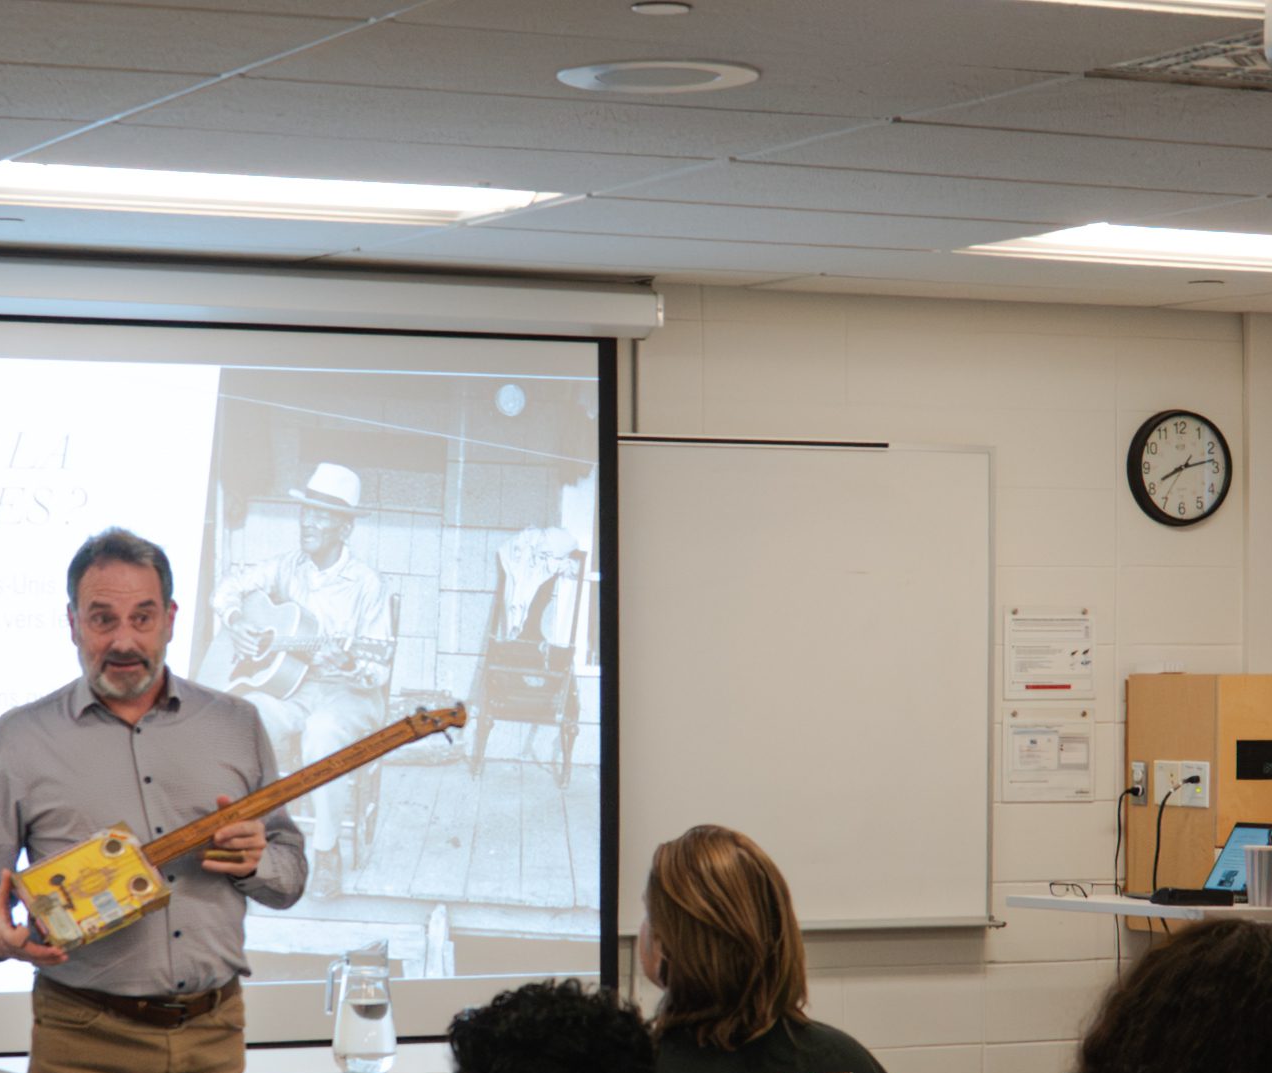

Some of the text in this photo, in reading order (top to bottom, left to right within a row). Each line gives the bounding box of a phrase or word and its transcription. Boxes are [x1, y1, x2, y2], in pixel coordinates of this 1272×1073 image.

[1157, 427, 1167, 439] 11
[1173, 421, 1186, 435] 12
[8, 430, 74, 472] LA
[1146, 442, 1157, 455] 10
[1207, 442, 1215, 454] 2
[1143, 461, 1150, 474] 9
[1212, 461, 1219, 473] 3
[1149, 483, 1156, 495] 8
[1208, 483, 1214, 494] 4
[1162, 497, 1168, 509] 7
[1178, 503, 1185, 515] 6
[1197, 497, 1203, 509] 5
[4, 611, 45, 629] vers
